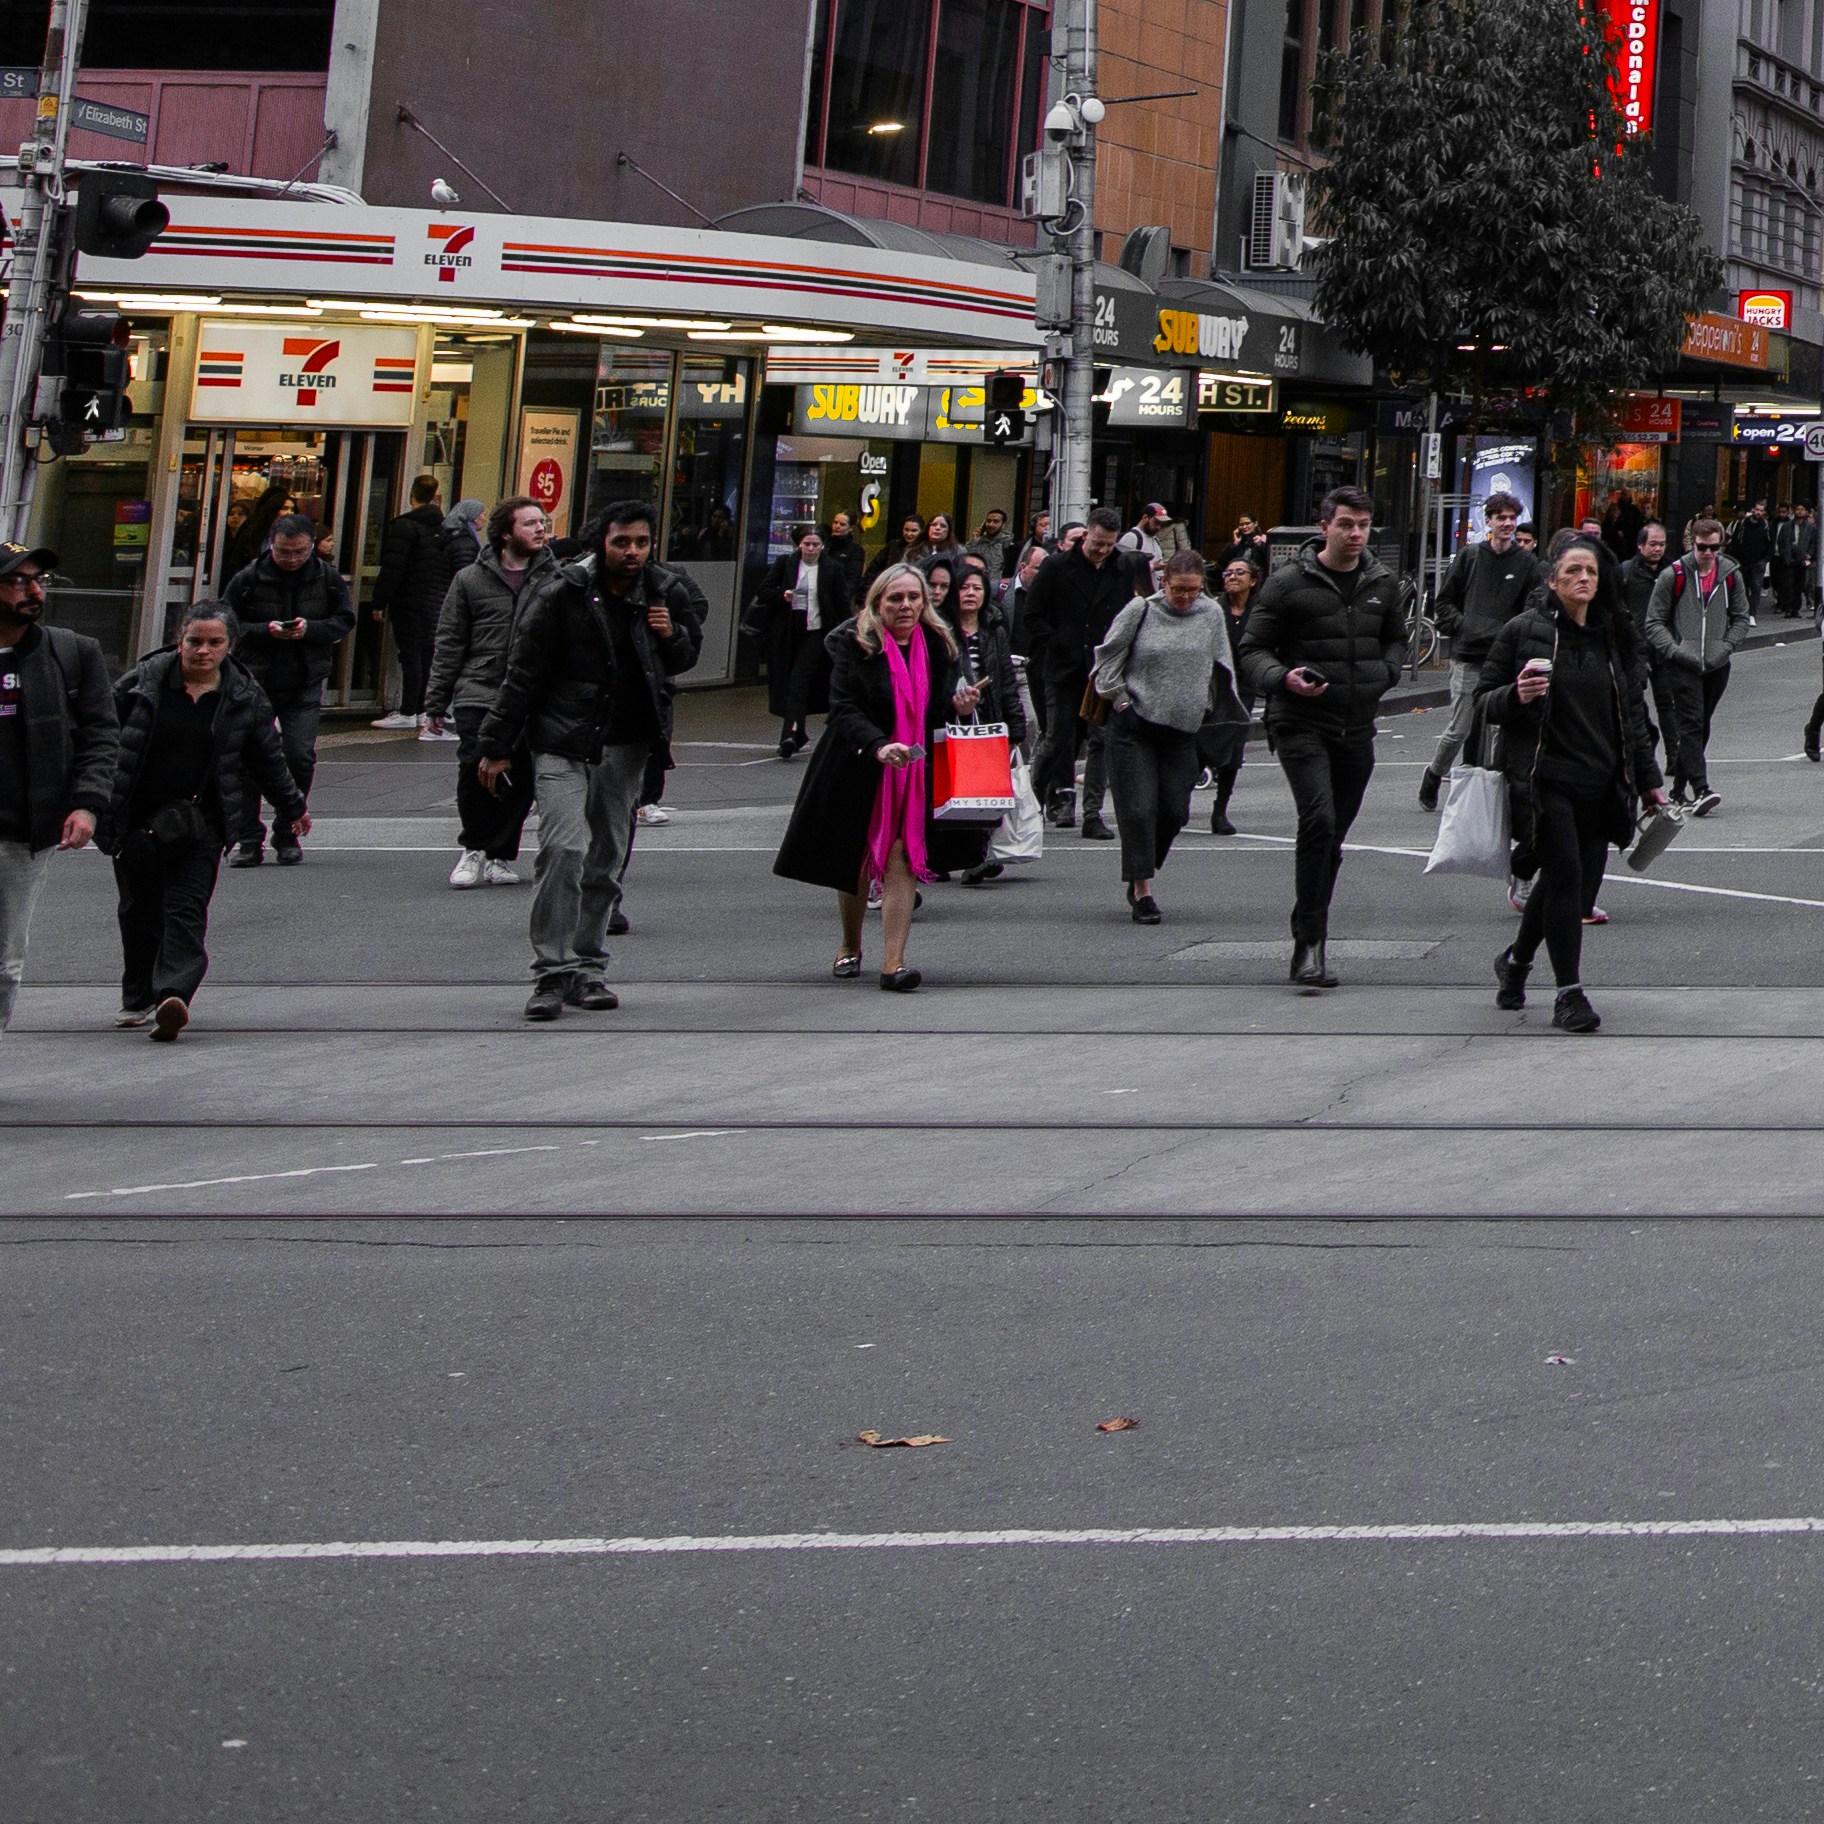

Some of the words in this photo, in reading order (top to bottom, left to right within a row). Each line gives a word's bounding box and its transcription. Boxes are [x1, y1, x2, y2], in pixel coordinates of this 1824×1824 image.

[3, 72, 25, 88] St
[86, 105, 133, 131] Elizabeth
[135, 117, 148, 135] St
[1095, 295, 1115, 327] 24
[1746, 307, 1782, 315] HUNGRY
[1153, 309, 1249, 360] SUBWAY
[1279, 326, 1296, 353] 24
[1751, 330, 1760, 351] 24
[1274, 352, 1298, 370] HOURS
[1139, 376, 1183, 404] 24
[807, 385, 919, 426] SUBWAY
[1138, 404, 1184, 417] HOURS
[1650, 403, 1672, 417] 24
[1649, 417, 1673, 425] HOURS
[1743, 427, 1775, 441] open
[861, 451, 887, 470] Open
[537, 471, 555, 496] $5
[947, 724, 1003, 736] MYER
[953, 799, 969, 807] MY
[976, 799, 1013, 807] STORE
